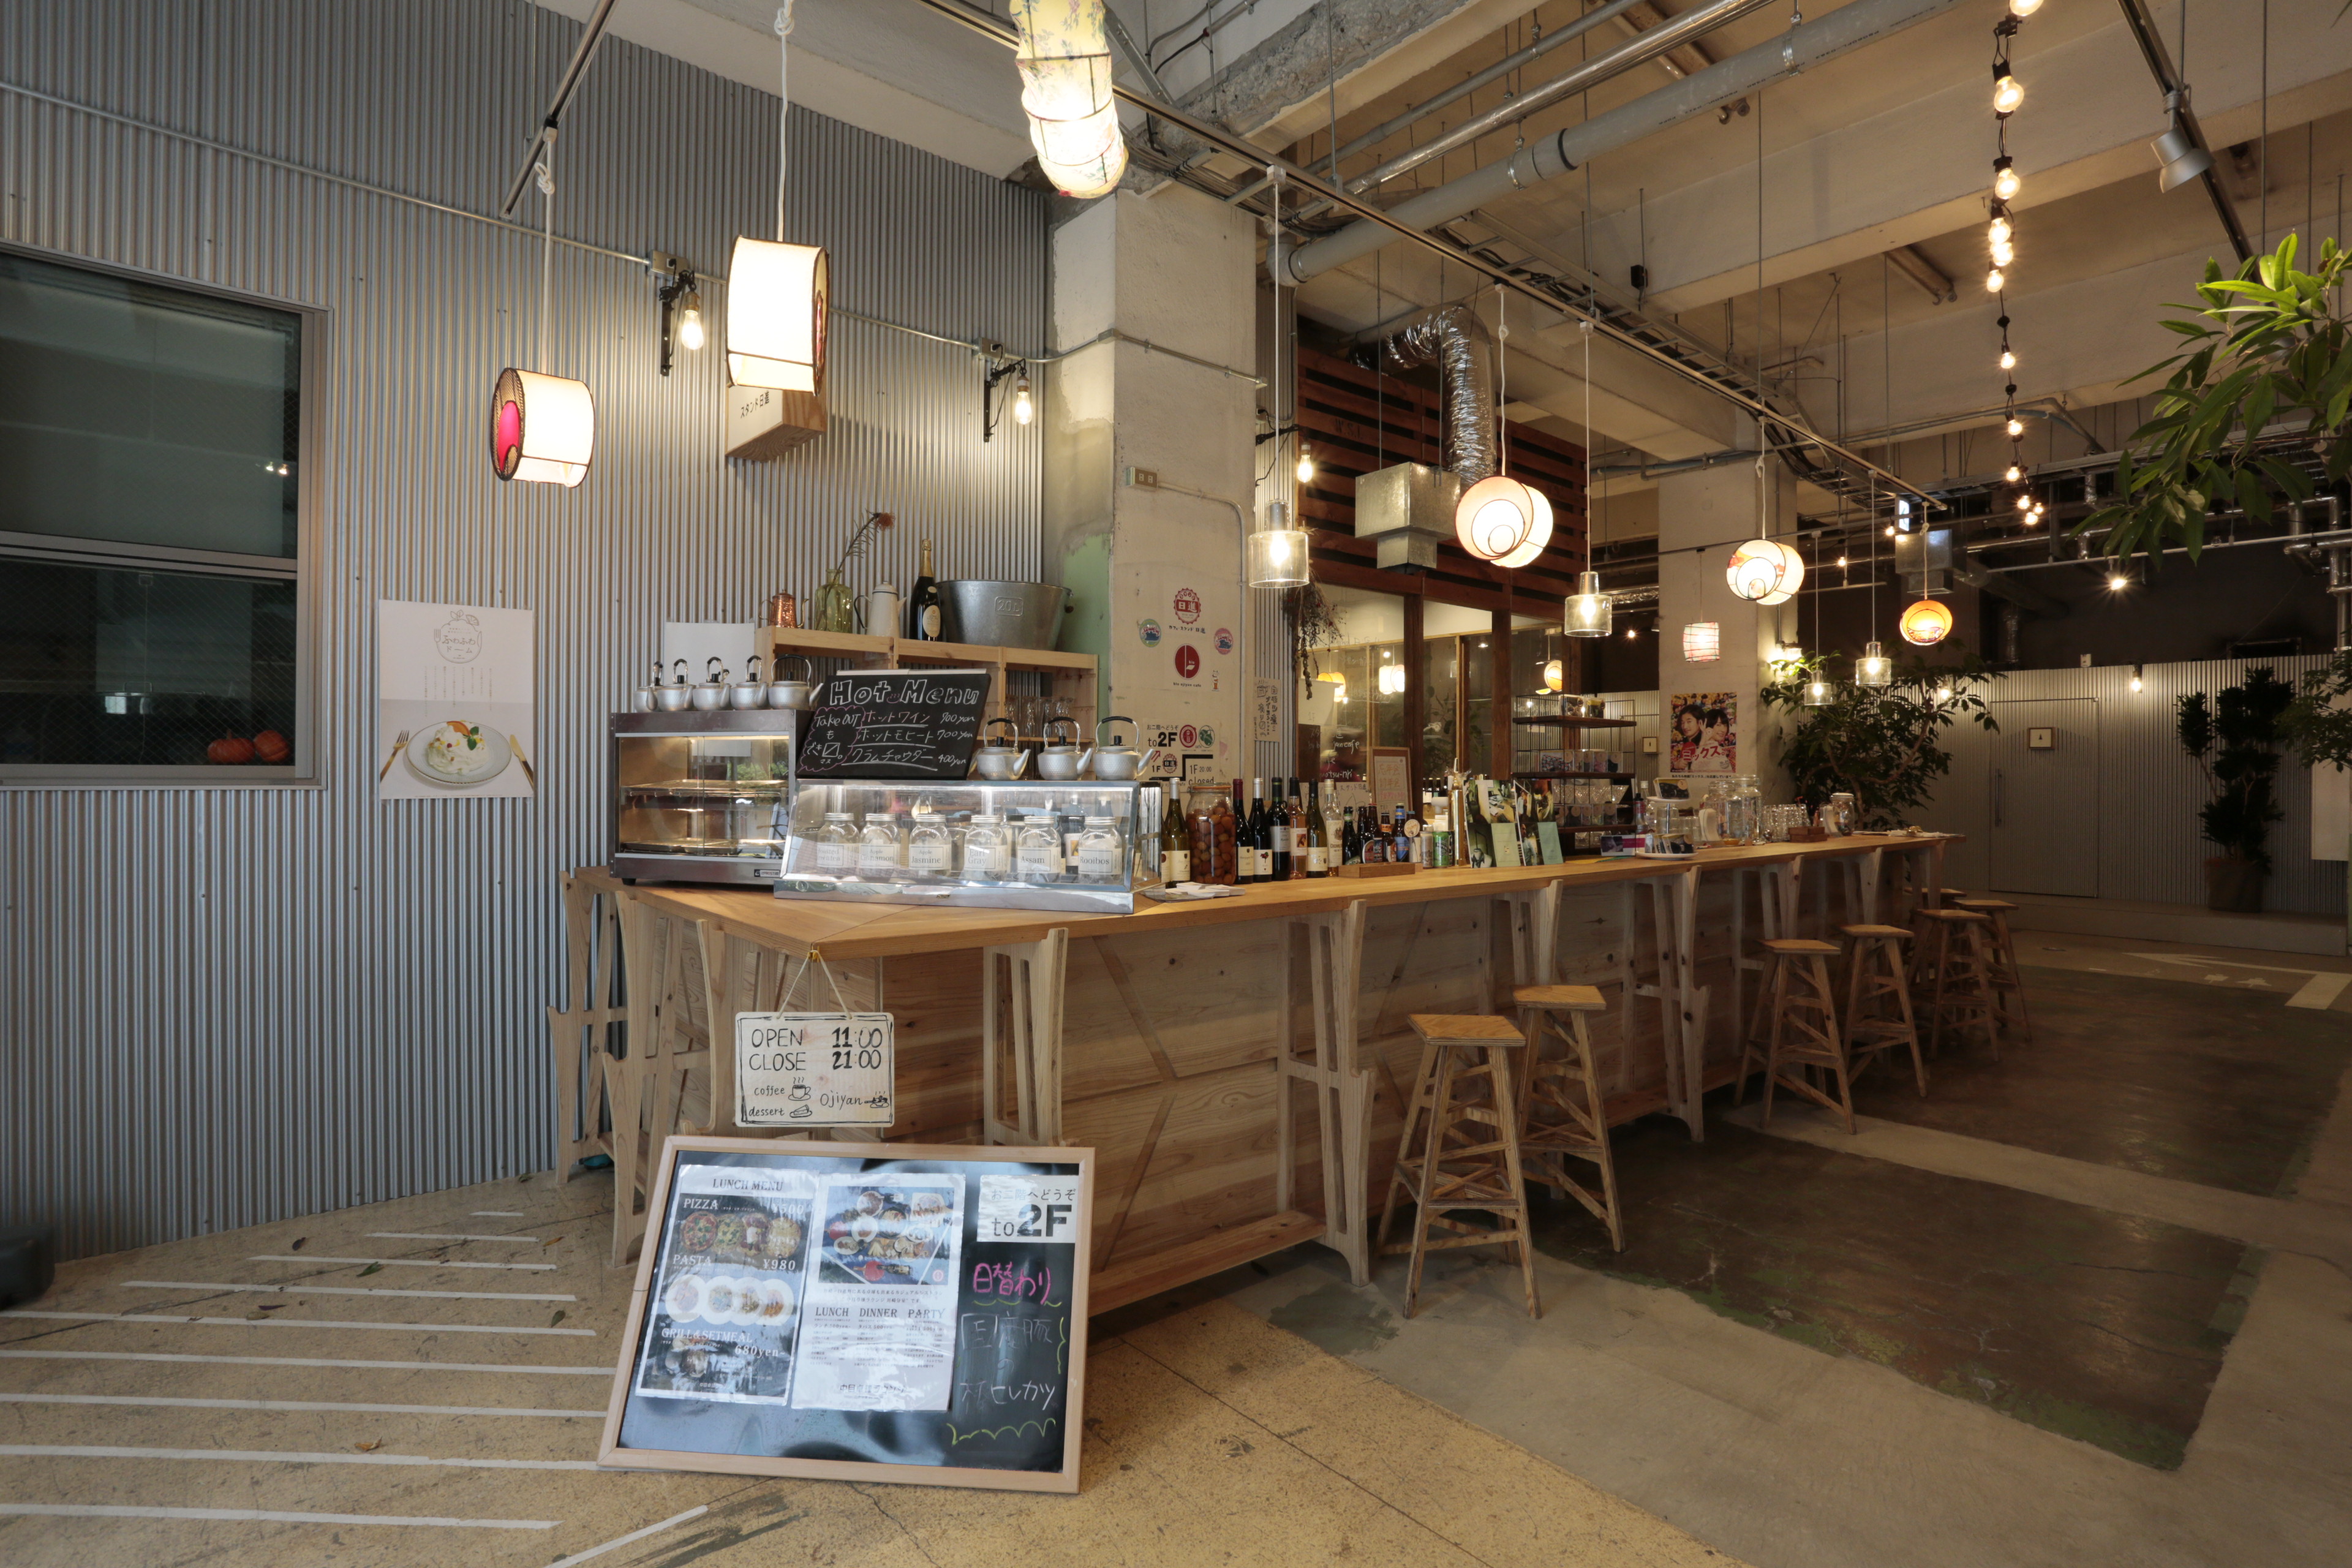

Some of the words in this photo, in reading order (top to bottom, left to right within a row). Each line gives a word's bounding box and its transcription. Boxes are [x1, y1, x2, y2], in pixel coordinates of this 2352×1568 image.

[741, 390, 770, 418] スタンド日進
[1178, 601, 1197, 612] 日進
[442, 635, 476, 645] ふわふわ
[829, 679, 891, 706] Hot
[900, 679, 979, 706] Menu
[816, 715, 841, 728] Take
[842, 714, 862, 728] OUT
[863, 710, 930, 723] ホットワイン
[826, 731, 835, 740] も
[858, 729, 934, 744] ホットモヒート
[1148, 737, 1157, 747] to
[1158, 731, 1178, 747] 2F
[1344, 740, 1360, 755] cafe
[851, 748, 933, 763] クラムチャウダー
[1152, 764, 1161, 773] 1F
[1189, 764, 1198, 774] 1F
[911, 855, 941, 864] Jasmine
[968, 857, 987, 867] Gray
[1020, 856, 1045, 864] Assam
[1079, 856, 1110, 865] Rooibos
[751, 1028, 803, 1048] OPEN
[831, 1027, 883, 1049] 11:00
[749, 1052, 807, 1071] CLOSE
[832, 1049, 881, 1071] 21:00
[754, 1085, 785, 1096] coffee
[748, 1106, 785, 1117] dessert
[713, 1178, 749, 1190] LUNCH
[751, 1181, 784, 1191] MENU
[991, 1188, 1076, 1201] お二階へどうぞ
[683, 1198, 719, 1210] PIZZA
[991, 1217, 1014, 1237] to
[1017, 1203, 1072, 1237] 2F
[673, 1254, 712, 1266] PASTA
[763, 1259, 796, 1270] ¥980
[973, 1261, 1052, 1305] 日替わり
[815, 1306, 850, 1317] LUNCH
[859, 1308, 898, 1318] DINNER
[907, 1308, 946, 1319] PARTY
